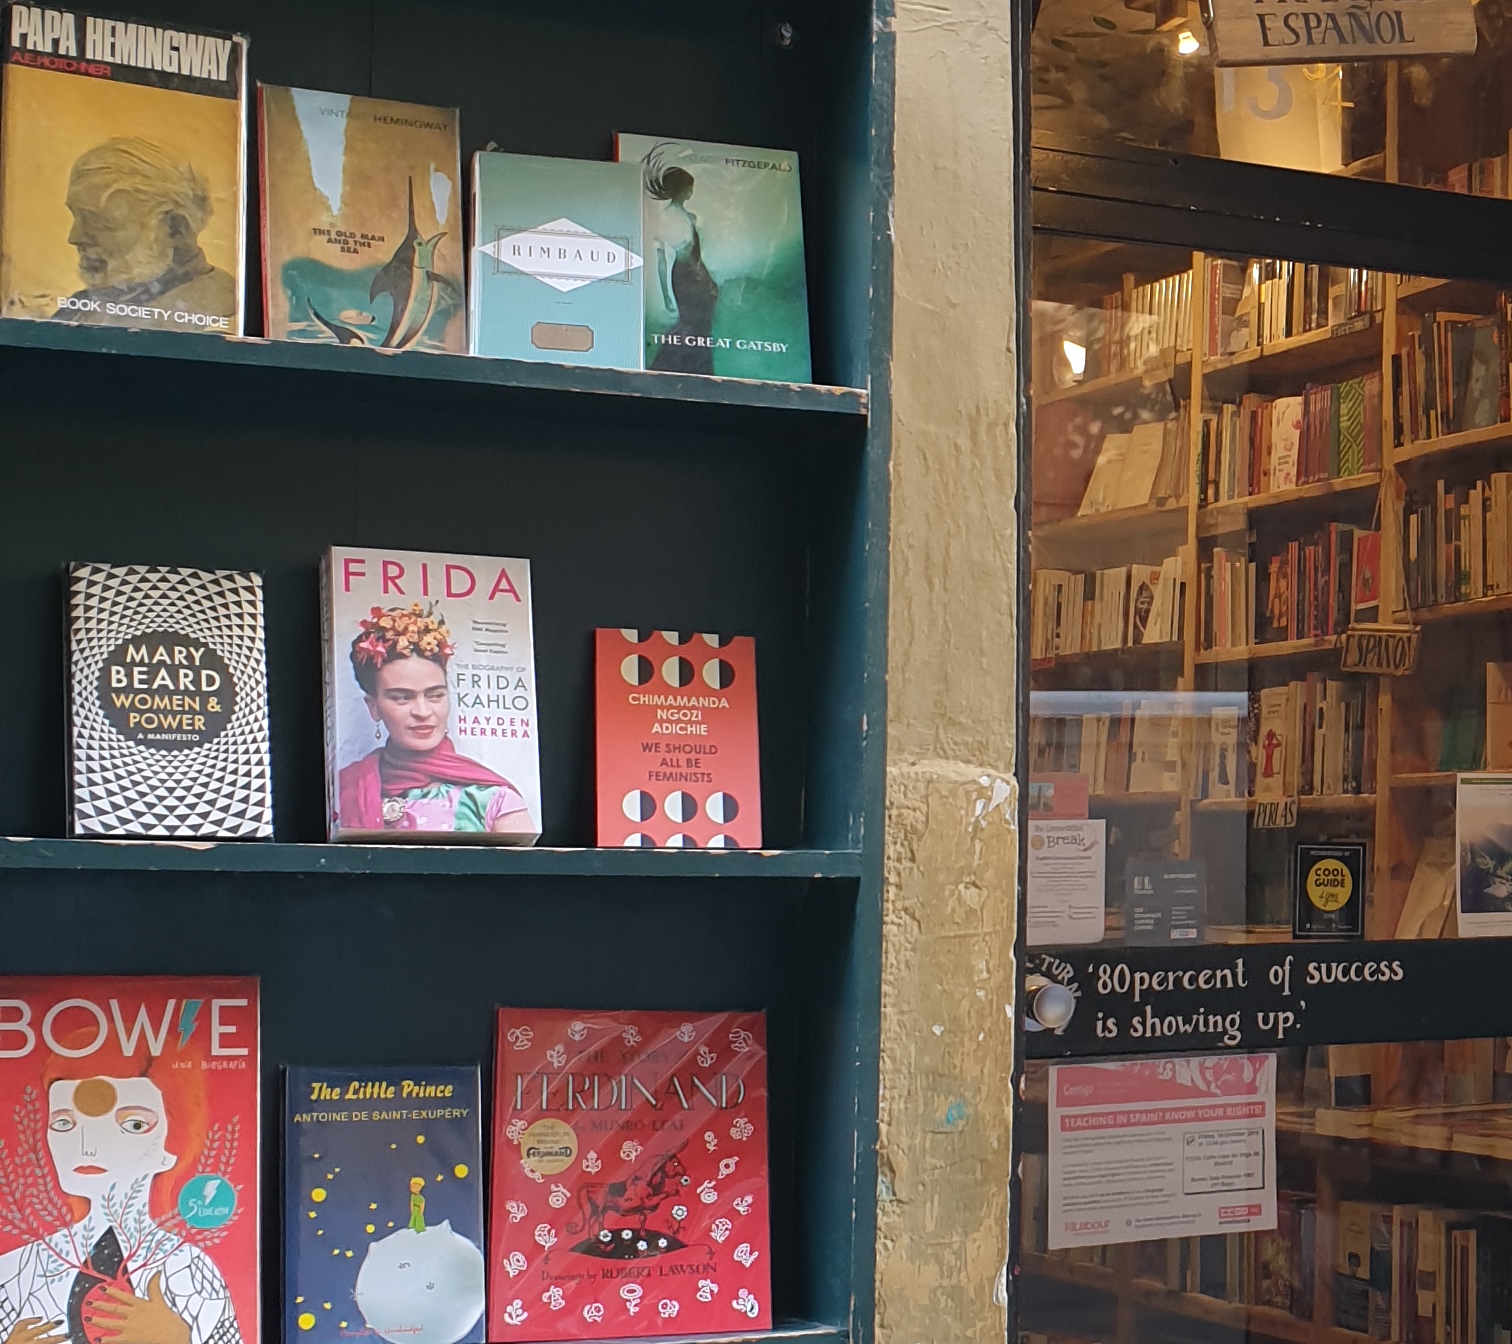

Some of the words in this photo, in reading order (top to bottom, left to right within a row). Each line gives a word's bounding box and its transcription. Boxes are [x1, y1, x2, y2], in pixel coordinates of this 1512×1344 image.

[1256, 4, 1416, 47] ESPAÑOL
[11, 4, 77, 57] PAPA
[85, 15, 232, 82] HEMINGWAY
[372, 113, 450, 132] HEMINGWAY
[724, 157, 793, 173] FITZGERALD
[312, 227, 332, 237] THE
[335, 230, 357, 239] OLD
[360, 232, 385, 243] MAN
[326, 237, 349, 247] AND
[352, 240, 372, 249] THE
[339, 246, 360, 255] SEA
[511, 243, 618, 264] RIMBAUD
[57, 296, 102, 313] BOOK
[105, 302, 172, 322] SOCIETY
[173, 310, 230, 329] CHOICE
[651, 333, 682, 347] THE
[684, 334, 734, 350] GREAT
[735, 338, 789, 354] GATSBY
[342, 556, 523, 604] FRIDA
[125, 643, 206, 667] MARY
[471, 663, 514, 672] BIOGRAPHY
[109, 665, 222, 692] BEARD
[456, 672, 528, 692] FRIDA
[110, 692, 201, 712] WOMEN
[206, 694, 222, 713] &
[457, 692, 529, 711] KAHLO
[628, 693, 730, 709] CHIMAMANDA
[128, 712, 207, 731] POWER
[458, 714, 530, 728] HAYDEN
[656, 709, 702, 721] NGOZI
[136, 731, 145, 740] A
[147, 731, 201, 742] MANIFESTO
[459, 726, 530, 739] HERRERA
[651, 722, 708, 736] ADICHIE
[640, 742, 662, 754] WE
[664, 743, 719, 755] SHOULD
[659, 757, 683, 769] ALL
[685, 758, 702, 769] BE
[648, 770, 713, 783] FEMINISTS
[1046, 833, 1086, 849] Break
[1314, 867, 1346, 877] COOL
[1314, 877, 1346, 888] GUIDE
[1268, 954, 1294, 996] of
[1306, 959, 1405, 984] success
[1095, 1011, 1118, 1038] is
[1129, 1004, 1243, 1046] showing
[310, 1081, 344, 1102] The
[345, 1079, 396, 1100] Little
[400, 1079, 454, 1099] Prince
[512, 1072, 747, 1112] FERDINAND
[293, 1112, 349, 1124] ANTOINE
[352, 1112, 370, 1122] DE
[371, 1107, 470, 1121] SAINT-EXUPÉRY
[1064, 1113, 1115, 1128] TEACHING
[1116, 1113, 1128, 1125] IN
[1129, 1111, 1164, 1124] SPAIN?
[1164, 1109, 1196, 1121] KNOW
[1197, 1107, 1225, 1119] YOUR
[601, 1266, 652, 1280] ROBERT
[658, 1261, 719, 1277] LAWSON
